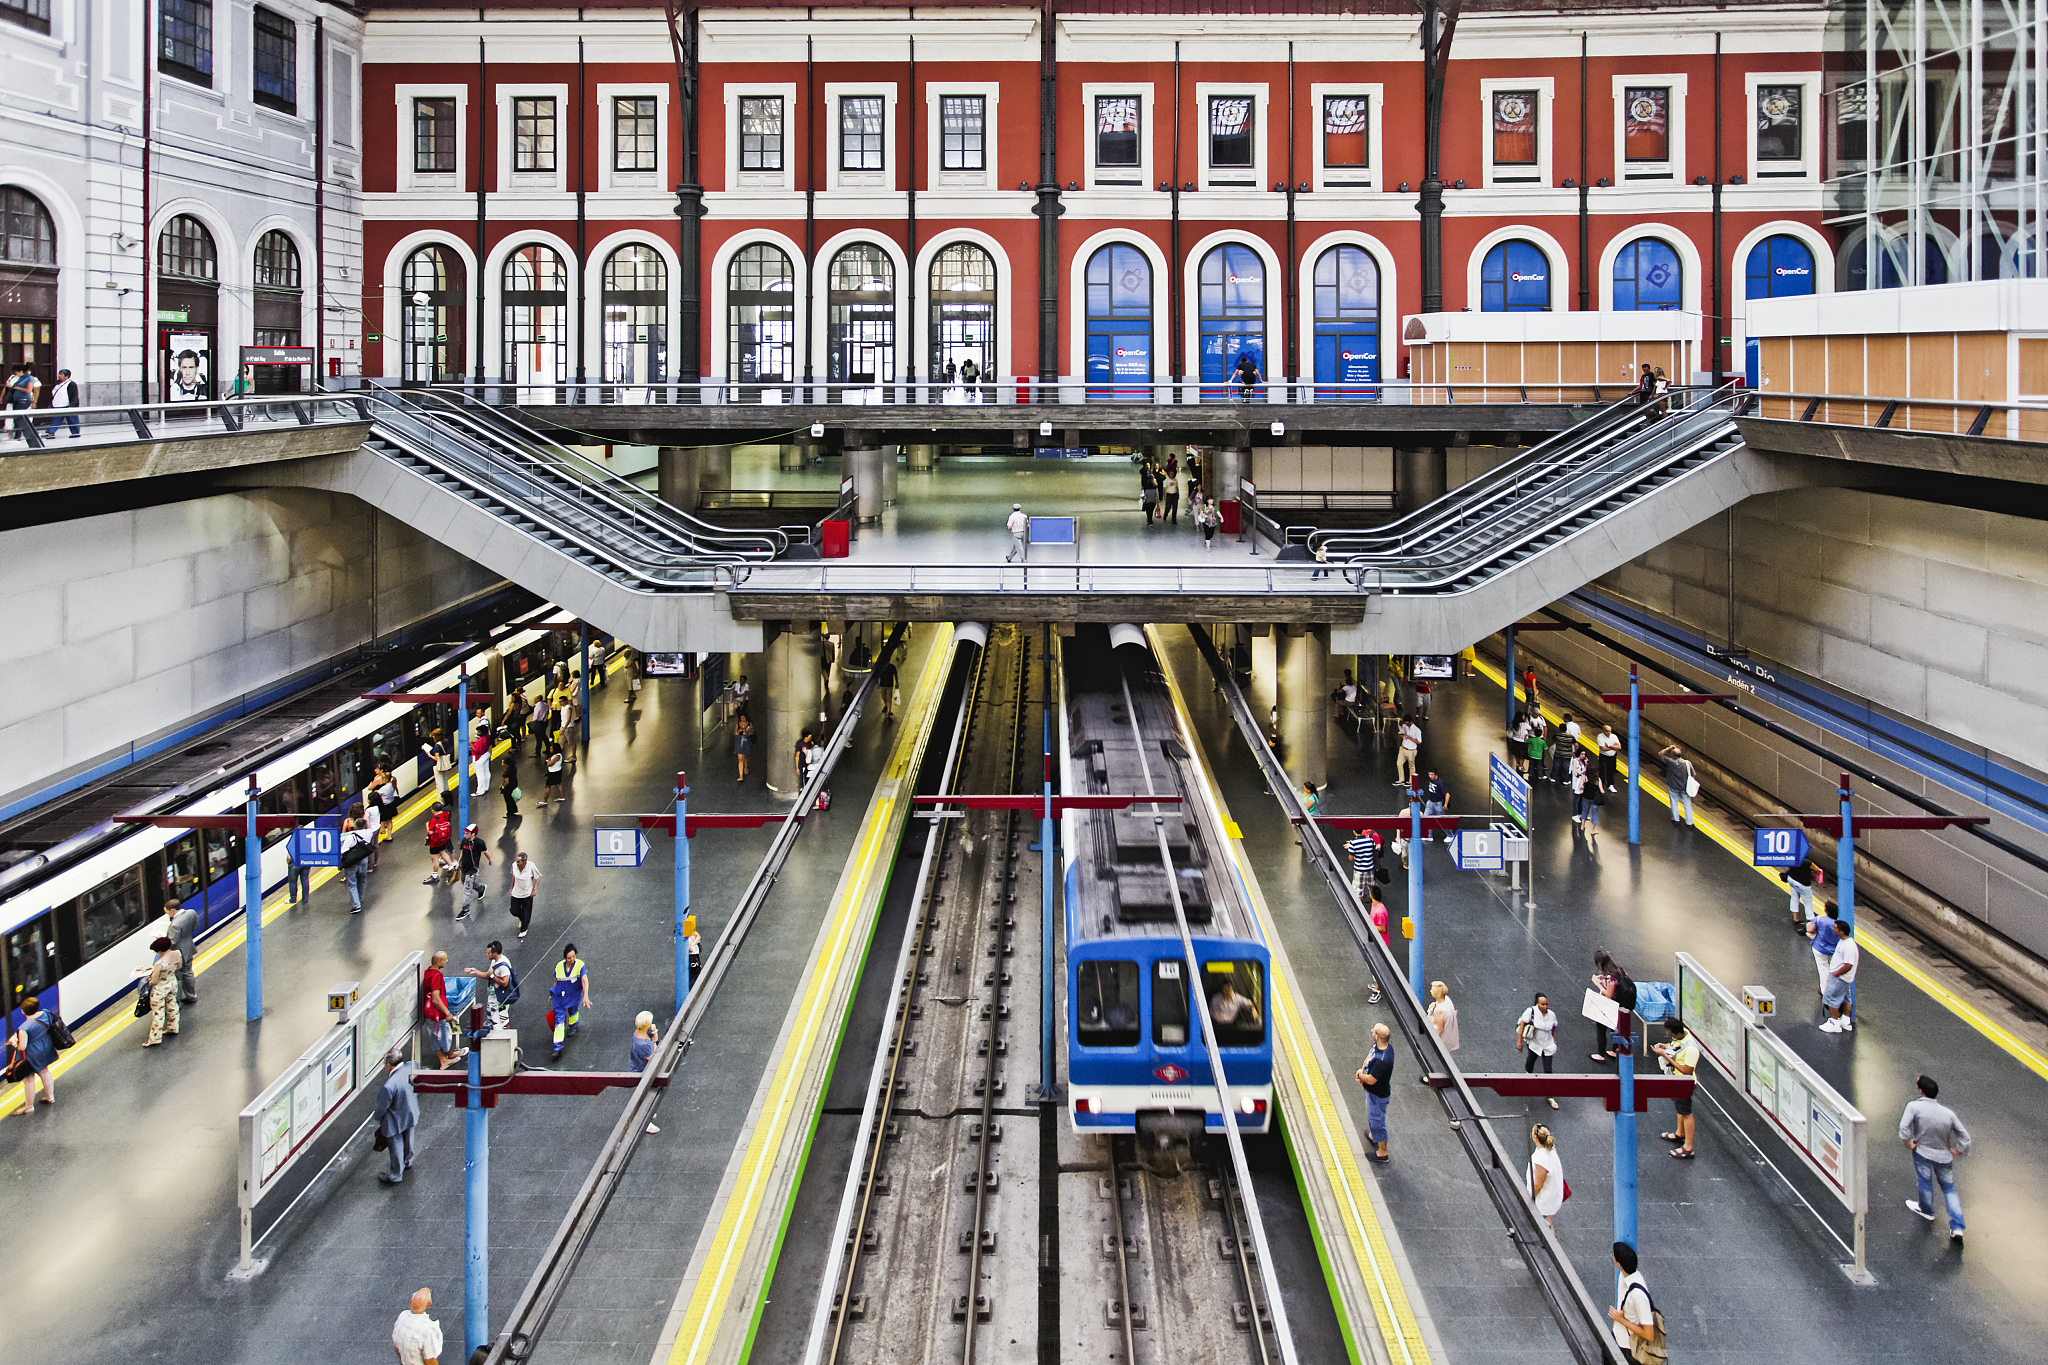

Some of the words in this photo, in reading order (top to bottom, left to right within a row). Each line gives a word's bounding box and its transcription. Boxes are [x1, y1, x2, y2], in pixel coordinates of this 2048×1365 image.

[1230, 276, 1262, 284] OpenCor
[1512, 274, 1544, 282] OpenCor
[1776, 268, 1809, 276] OpenCor
[1343, 353, 1377, 361] OpenCor
[1728, 674, 1749, 692] Andén
[1750, 685, 1755, 694] 2
[306, 831, 331, 853] 10
[610, 832, 623, 853] 6
[1475, 833, 1488, 855] 6
[1764, 831, 1790, 853] 10
